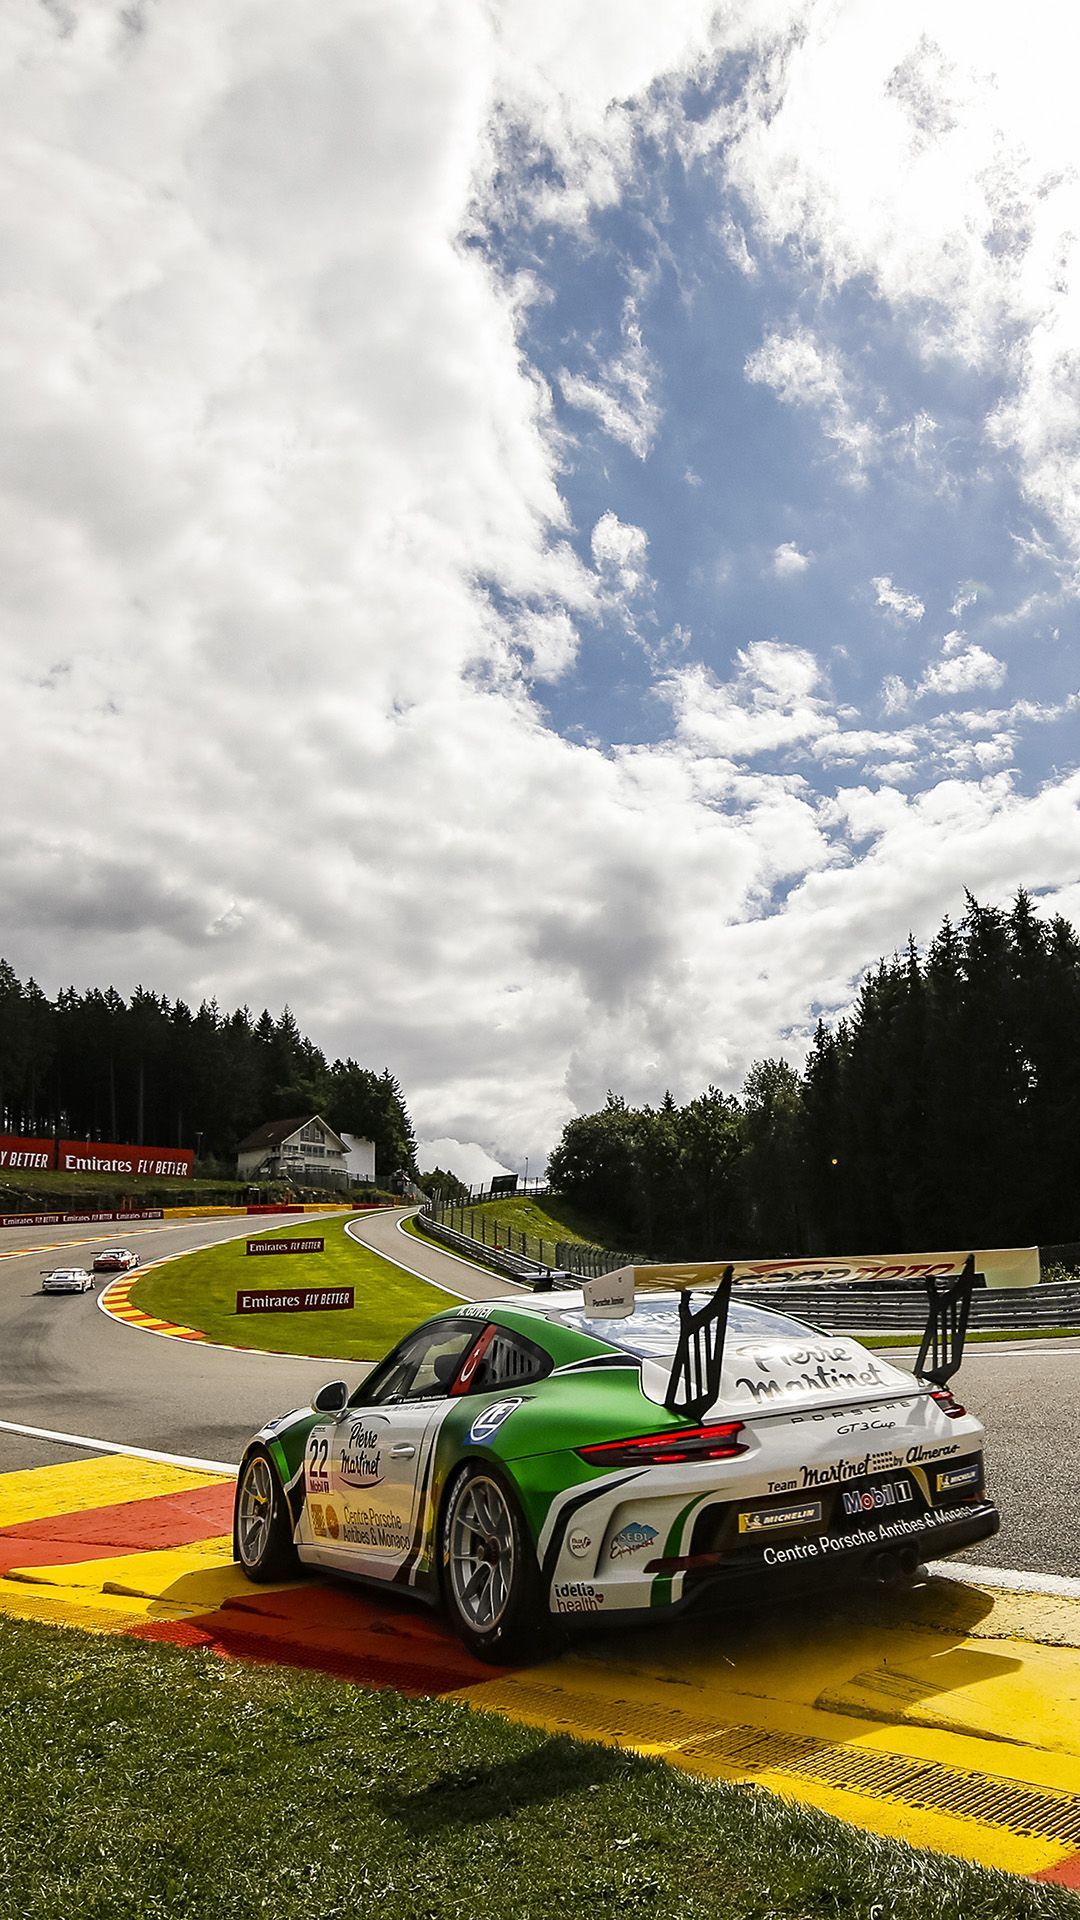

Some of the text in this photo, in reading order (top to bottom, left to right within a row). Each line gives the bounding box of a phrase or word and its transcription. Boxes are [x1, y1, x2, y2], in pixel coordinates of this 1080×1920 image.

[9, 1151, 49, 1168] BETTER
[65, 1155, 188, 1176] Emirates FLY BETTER
[249, 1242, 288, 1252] Emirates
[242, 1292, 350, 1308] Emirates FLY BETTER
[735, 1345, 852, 1373] Pierre
[735, 1363, 889, 1404] Martinet
[791, 1401, 911, 1425] PORSCHE
[348, 1421, 378, 1449] Pierre
[309, 1439, 329, 1478] 22
[340, 1449, 381, 1478] Martinet
[768, 1480, 797, 1493] Team
[800, 1453, 871, 1487] Martinet
[893, 1456, 904, 1466] by
[309, 1480, 325, 1493] Mobil
[842, 1482, 895, 1515] Mobil
[343, 1506, 368, 1526] Centre
[368, 1508, 402, 1530] Porsche
[763, 1509, 815, 1524] MICHELIN
[343, 1524, 410, 1551] Antibes & Monaco
[763, 1505, 974, 1565] Centre Porsche Antibes & Monaco
[554, 1583, 595, 1597] idelia
[556, 1597, 599, 1612] health
